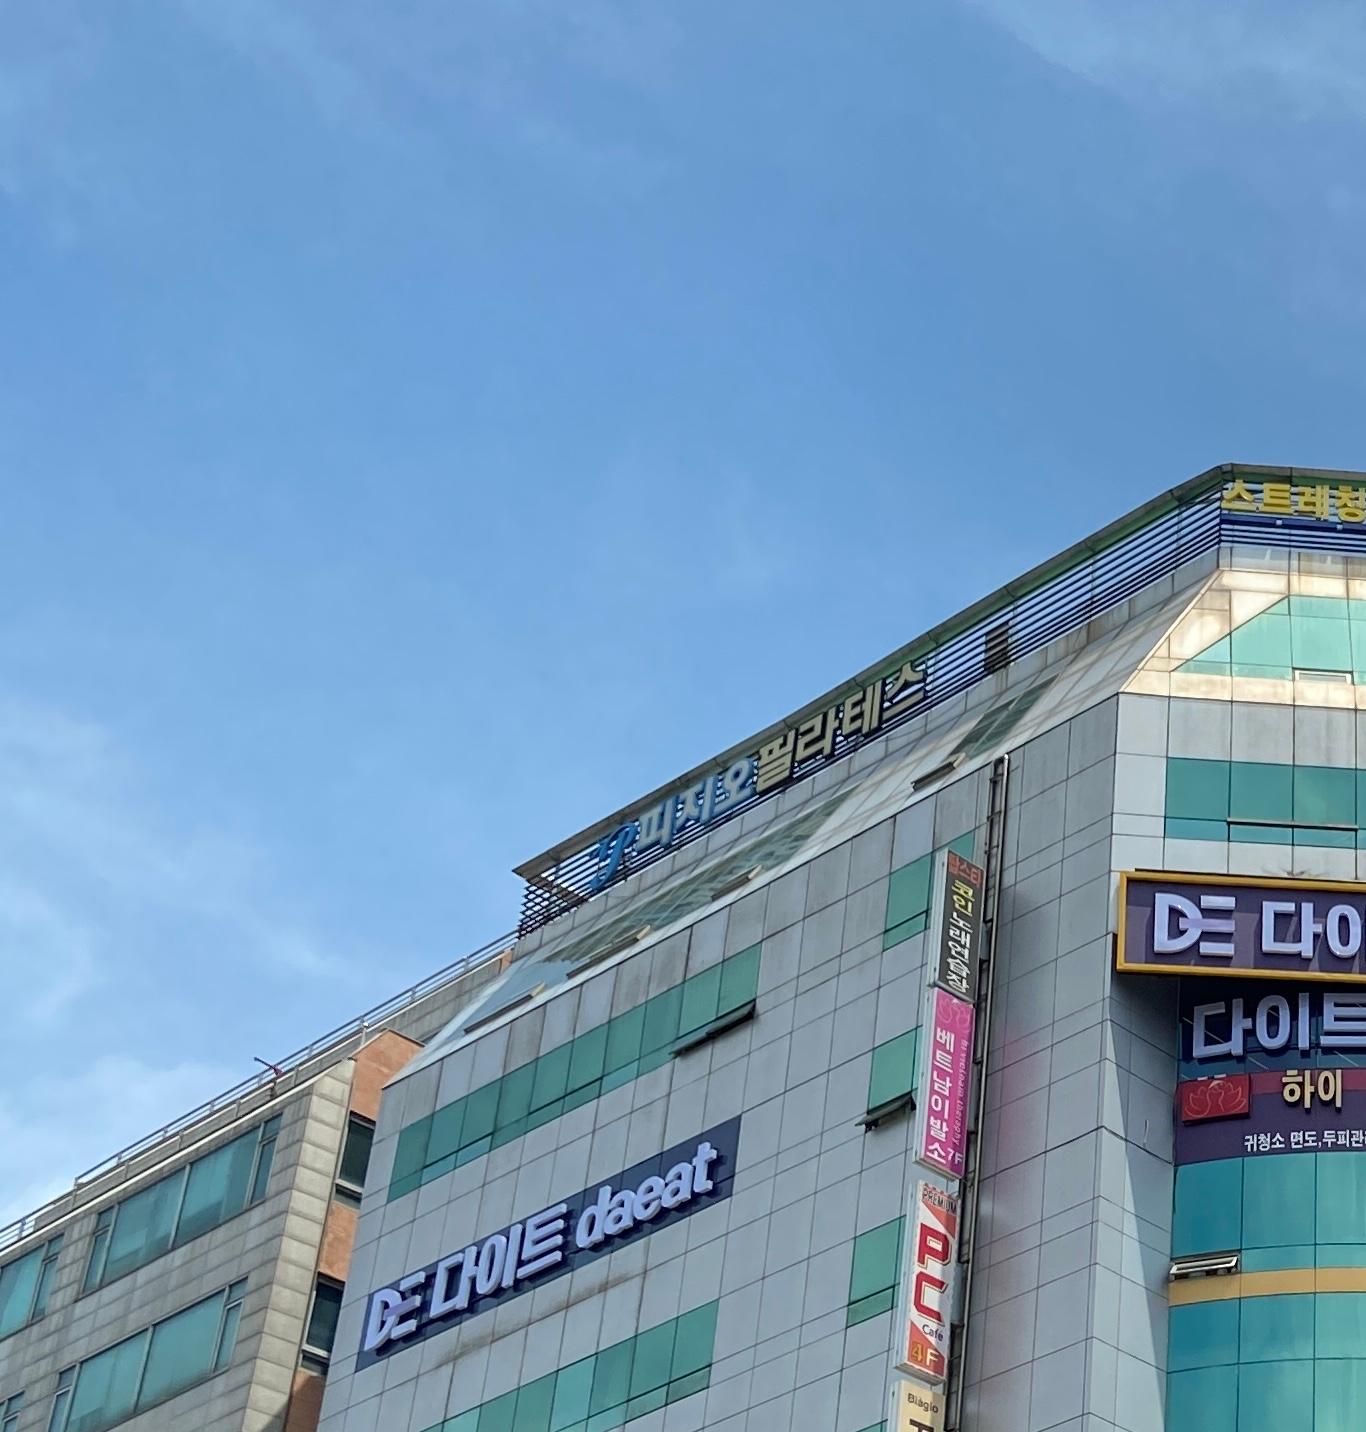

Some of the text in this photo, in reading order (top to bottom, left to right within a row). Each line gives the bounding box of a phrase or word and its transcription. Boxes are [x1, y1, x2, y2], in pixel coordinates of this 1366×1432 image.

[1221, 479, 1366, 523] 스트레칭
[926, 1027, 955, 1164] 베트남이발소
[1282, 1068, 1342, 1109] 하이
[946, 1147, 964, 1165] 7F
[1244, 1133, 1286, 1153] 귀청소
[921, 1187, 958, 1212] PREMIUM
[429, 1142, 717, 1319] 다이트 daeat
[913, 1221, 955, 1324] PC
[910, 1342, 940, 1369] 4F
